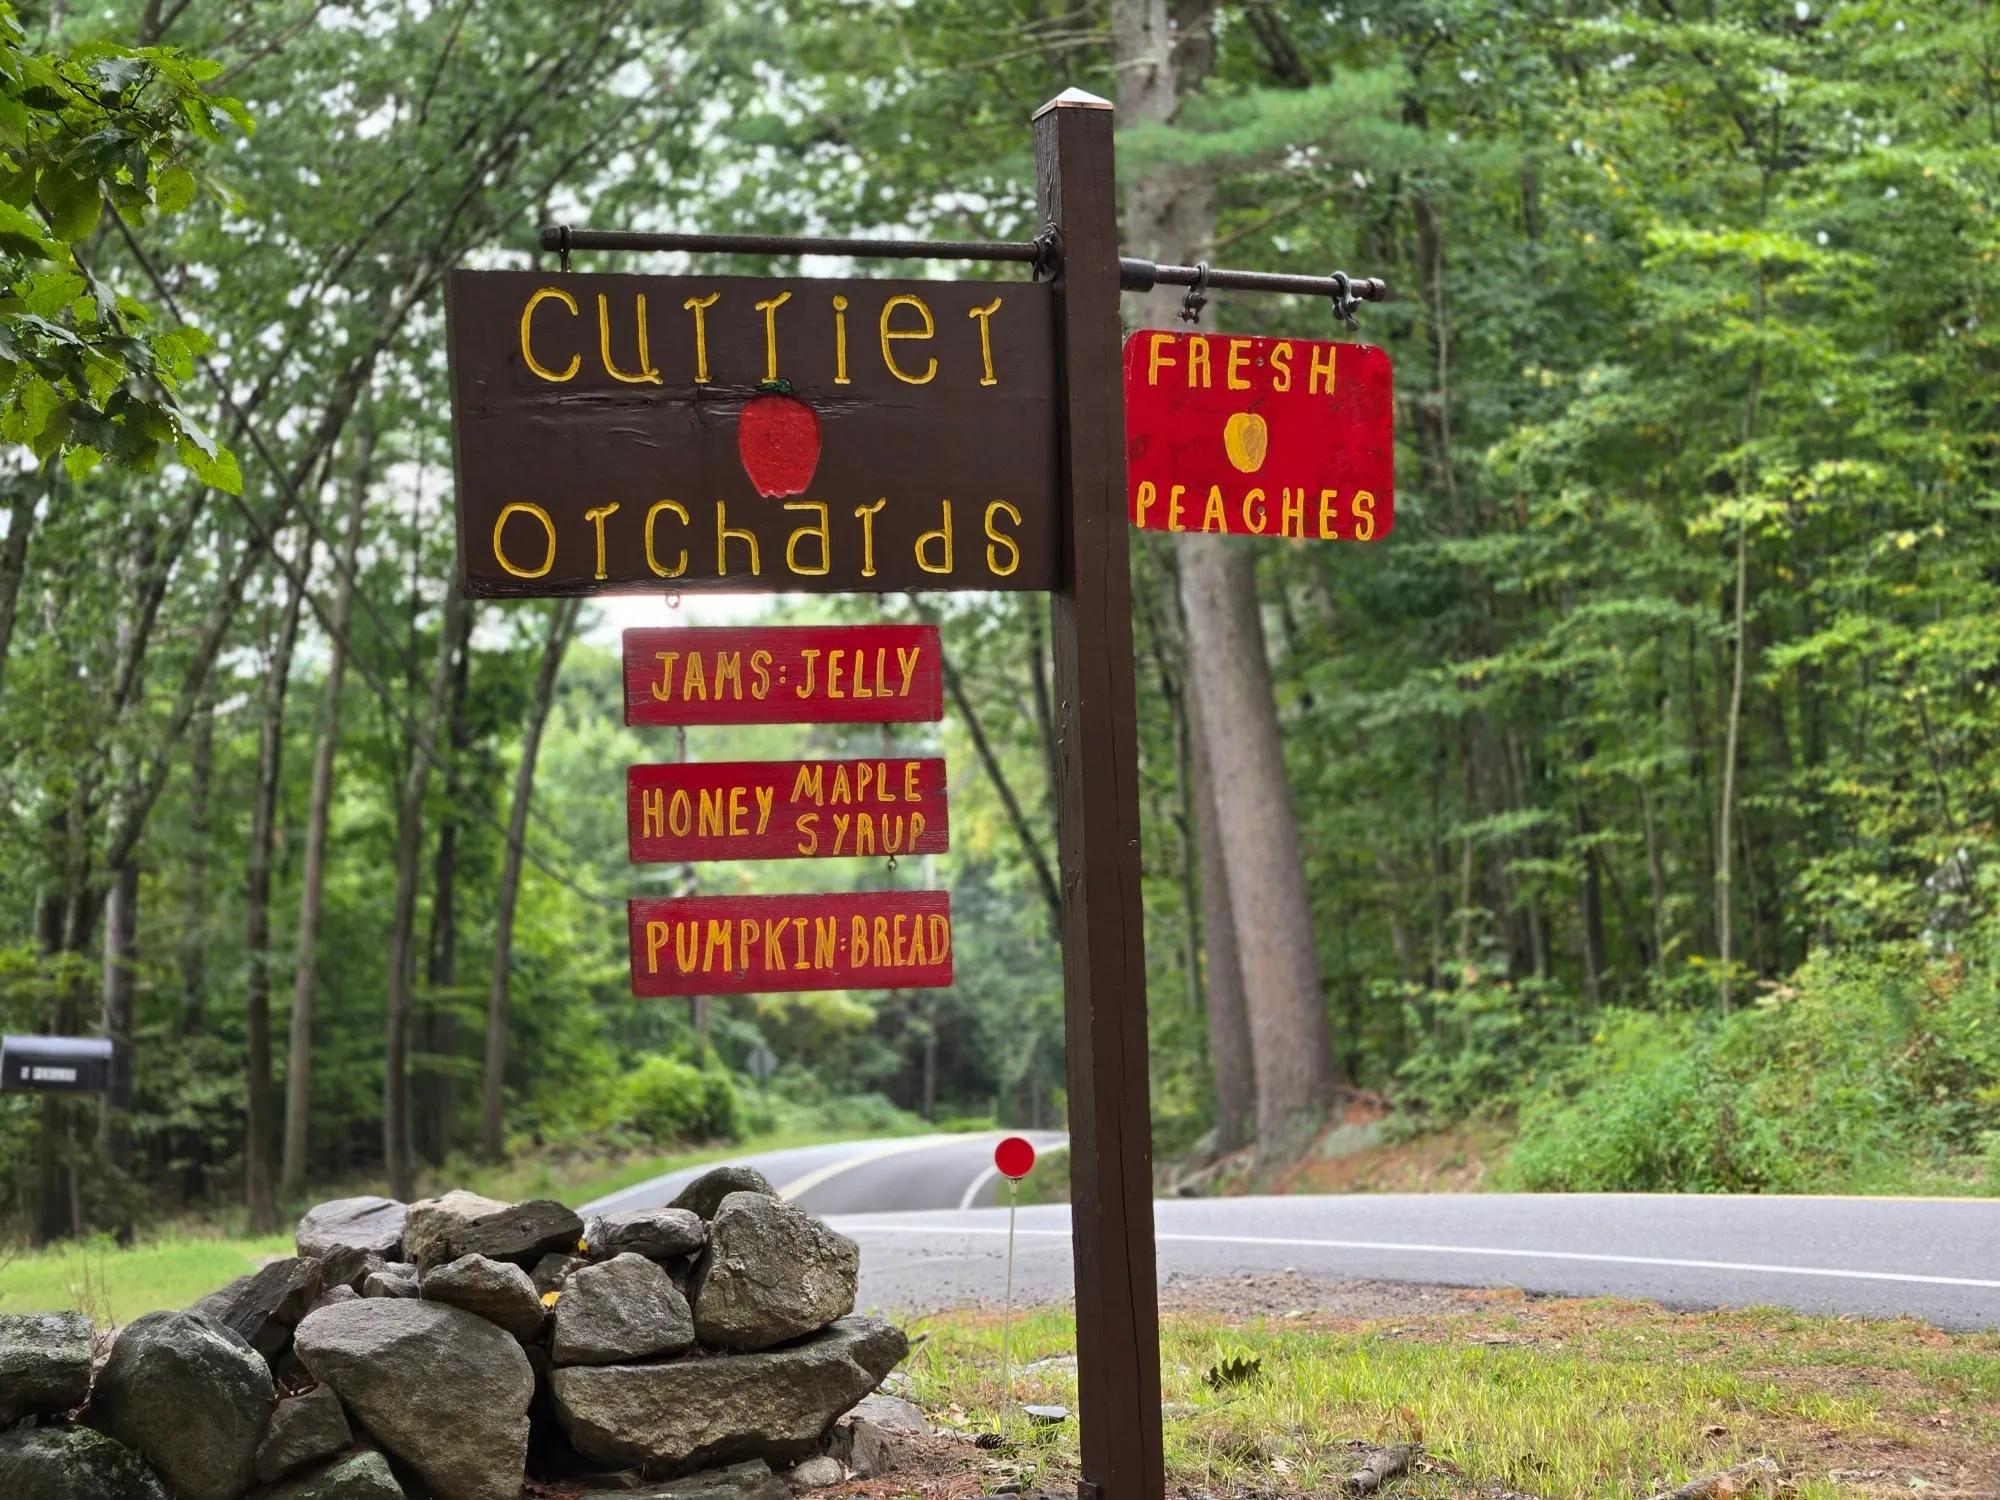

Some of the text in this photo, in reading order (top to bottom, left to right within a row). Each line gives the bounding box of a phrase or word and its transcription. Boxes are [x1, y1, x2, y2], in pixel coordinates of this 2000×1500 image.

[1148, 333, 1337, 395] FRESH
[1136, 481, 1376, 541] PEACHES
[790, 761, 922, 806] MAPLE
[641, 785, 774, 839] HONEY
[795, 811, 926, 857] SYRUP
